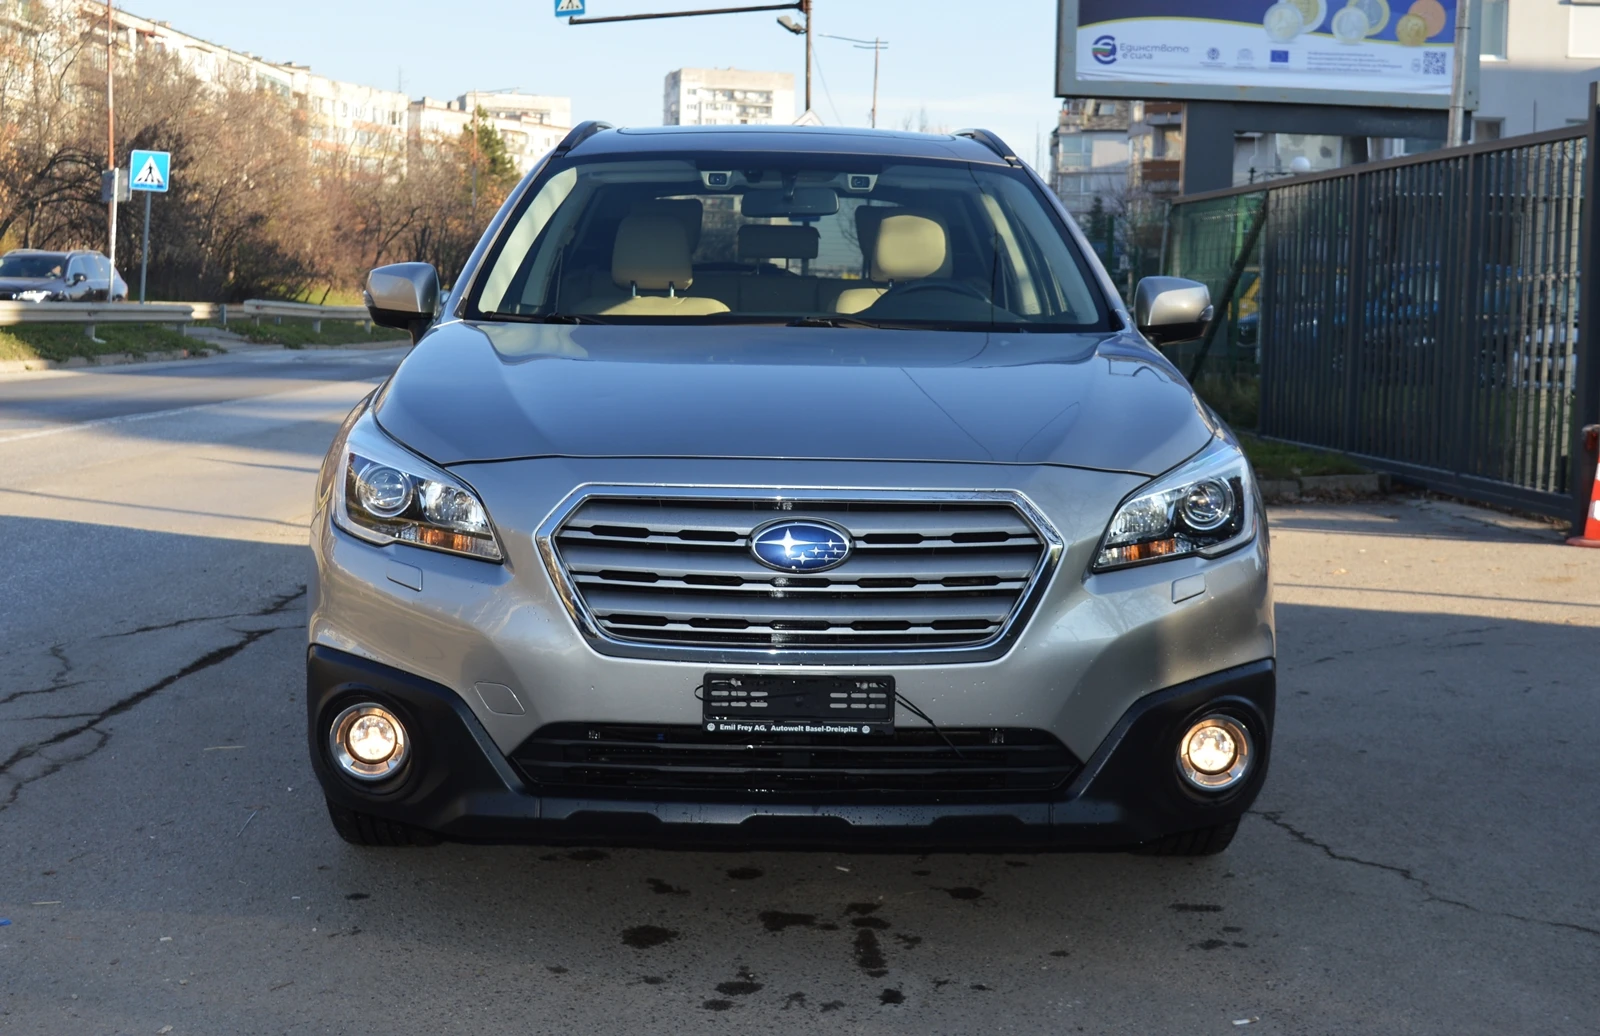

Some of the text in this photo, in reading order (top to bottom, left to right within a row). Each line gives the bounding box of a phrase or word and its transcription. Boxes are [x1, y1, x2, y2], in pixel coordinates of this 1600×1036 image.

[1119, 43, 1189, 53] Единството
[719, 723, 736, 731] Emil
[737, 724, 753, 732] Frey
[806, 725, 858, 733] Basel-Dreispitz
